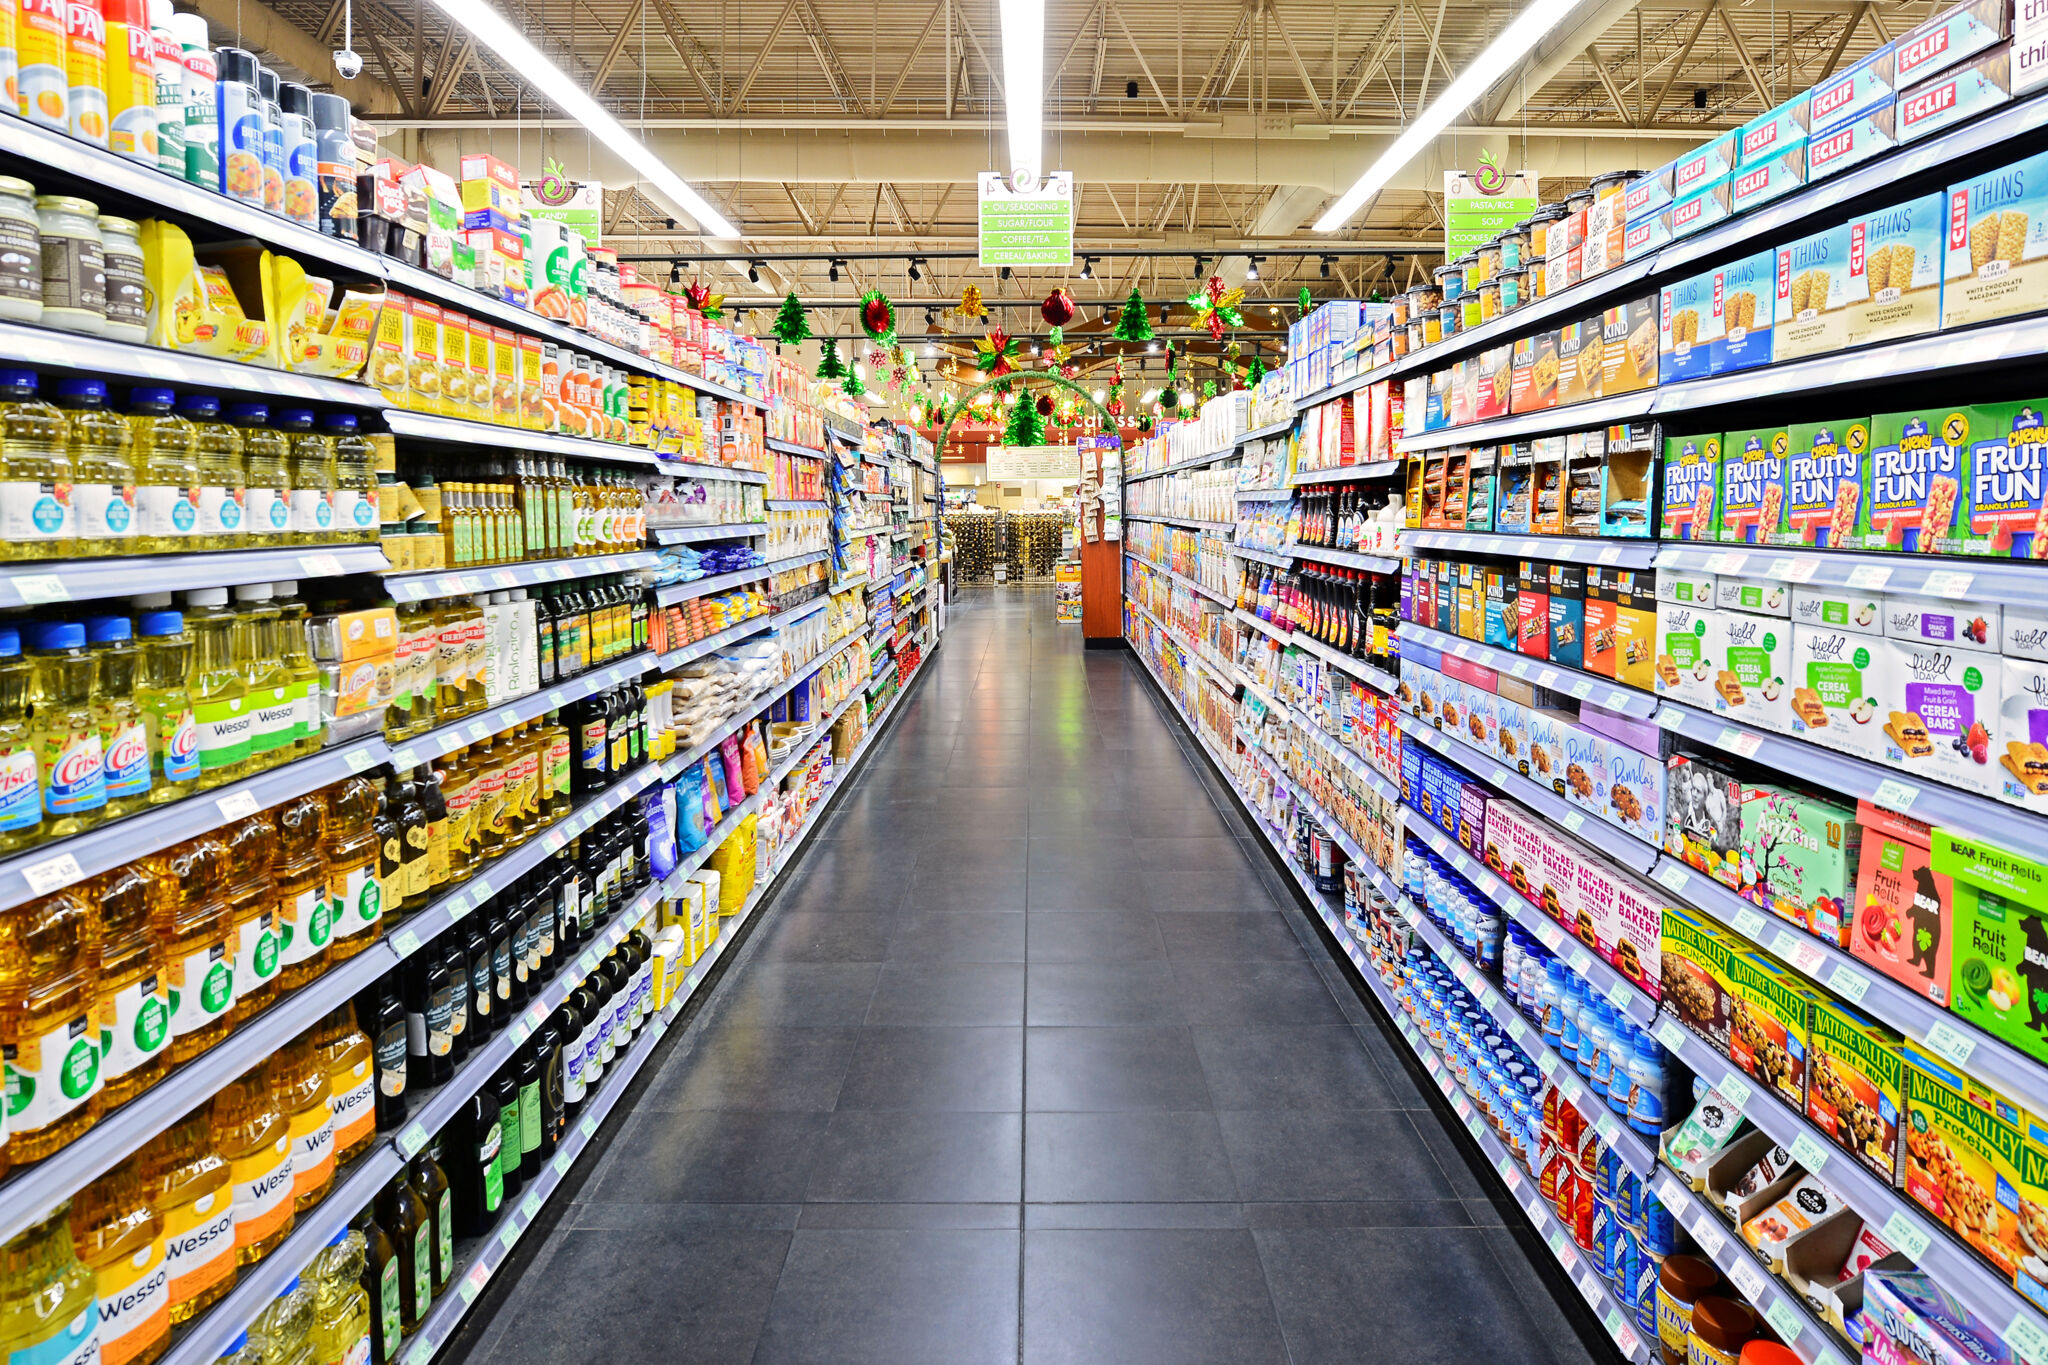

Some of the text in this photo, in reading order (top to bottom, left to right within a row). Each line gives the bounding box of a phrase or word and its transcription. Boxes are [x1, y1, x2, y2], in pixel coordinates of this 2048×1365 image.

[1909, 28, 1948, 65] CLIF
[1821, 82, 1853, 111] CLIF
[1914, 85, 1955, 118] CLIF
[1752, 124, 1776, 148] CLIF
[1820, 132, 1852, 160] CLIF
[1684, 158, 1706, 181] CLIF
[1742, 169, 1769, 196] CLIF
[1973, 170, 2024, 211] THINS
[992, 202, 1058, 211] OIL/SEASONING
[1470, 201, 1515, 209] PASTA/RICE
[1632, 187, 1649, 207] CLIF
[538, 212, 568, 220] CANDY
[1481, 217, 1504, 226] SOUP
[1679, 200, 1700, 223] CLIF
[1952, 195, 1967, 244] CLIF
[997, 219, 1054, 228] SUGAR/FLOUR
[1870, 208, 1912, 242] THINS
[1001, 234, 1050, 244] COFFEE/TEA
[1632, 226, 1650, 246] CLIF
[993, 251, 1058, 260] CEREAL/BAKING
[1794, 237, 1829, 267] THINS
[1852, 227, 1865, 271] CLIF
[1726, 262, 1755, 288] THINS
[1779, 254, 1790, 294] CLIF
[1673, 282, 1698, 306] THINS
[1714, 275, 1724, 313] CLIF
[1966, 277, 2023, 295] WHITE CHOCOLATE
[1969, 286, 2019, 301] MACADAMIA NUT
[1663, 292, 1672, 328] CLIF
[1866, 304, 1914, 317] WHITE CHOCOLATE
[1869, 310, 1912, 323] MACADAMIA NUT
[416, 322, 435, 339] FISH
[447, 333, 464, 347] FISH
[1604, 321, 1628, 339] KIND
[1560, 337, 1581, 354] KIND
[1480, 362, 1495, 376] KIND
[1514, 350, 1534, 366] KIND
[1608, 439, 1632, 454] KIND
[1501, 455, 1517, 467] KIND
[1725, 458, 1782, 485] FRUITY
[1790, 451, 1858, 482] FRUITY
[1874, 443, 1956, 478] FRUITY
[1666, 461, 1714, 486] FRUITY
[1666, 481, 1697, 505] FUN
[1725, 479, 1763, 505] FUN
[1790, 477, 1835, 505] FUN
[1874, 471, 1927, 504] FUN
[1975, 469, 2041, 505] FUN
[1791, 501, 1827, 511] GRANOLA BARS
[1874, 500, 1917, 510] GRANOLA BARS
[1975, 500, 2029, 512] GRANOLA BARS
[1550, 574, 1562, 584] KIND
[1587, 575, 1601, 586] KIND
[1618, 582, 1633, 594] KIND
[1487, 585, 1504, 598] KIND
[1927, 623, 1948, 633] SNACK
[1930, 630, 1946, 638] BARS
[1672, 648, 1694, 658] CEREAL
[1676, 656, 1691, 666] BARS
[1735, 664, 1763, 674] CEREAL
[1740, 673, 1759, 683] BARS
[1918, 672, 1940, 682] DAY
[1817, 681, 1851, 694] CEREAL
[1822, 692, 1846, 704] BARS
[1923, 687, 1957, 698] Mixed Berry
[1920, 704, 1962, 719] CEREAL
[1922, 696, 1936, 704] Fruit
[1942, 697, 1958, 706] Grain
[1926, 716, 1956, 731] BARS
[1668, 757, 1679, 768] NEW!
[1728, 782, 1740, 800] 10
[1741, 790, 1756, 802] NEW!
[1756, 811, 1820, 852] AriZona
[1825, 820, 1841, 842] 10
[1512, 831, 1541, 858] BAKERY
[1542, 853, 1574, 882] BAKERY
[1950, 841, 1976, 860] BEAR
[1980, 852, 2007, 871] Fruit
[2011, 864, 2042, 883] Rolls
[1973, 862, 1991, 876] JUST
[1992, 869, 2016, 883] FRUIT
[1772, 873, 1791, 889] Green
[1789, 879, 1802, 895] Tea
[1875, 869, 1902, 891] Fruit
[1577, 876, 1613, 909] BAKERY
[1873, 883, 1900, 906] Rolls
[1913, 892, 1939, 915] BEAR
[1618, 903, 1660, 939] BAKERY
[1663, 913, 1732, 975] NATURE VALLEY
[1973, 919, 2007, 948] Fruit
[1674, 941, 1718, 975] CRUNCHY
[1972, 936, 2007, 963] Rolls
[210, 978, 230, 995] CORN
[1733, 957, 1804, 1028] NATURE VALLEY
[1742, 986, 1792, 1028] Fruit NUT
[143, 1010, 163, 1033] CORN
[148, 1027, 161, 1043] OIL
[1814, 1008, 1900, 1085] NATURE VALLEY
[71, 1055, 93, 1078] CORN
[1824, 1038, 1886, 1088] Fruit NUT
[76, 1071, 90, 1089] OIL
[1912, 1070, 1965, 1118] NATURE
[1966, 1105, 2021, 1167] VALLEY
[1933, 1110, 1994, 1163] Protein
[1799, 1190, 1823, 1212] COCOA
